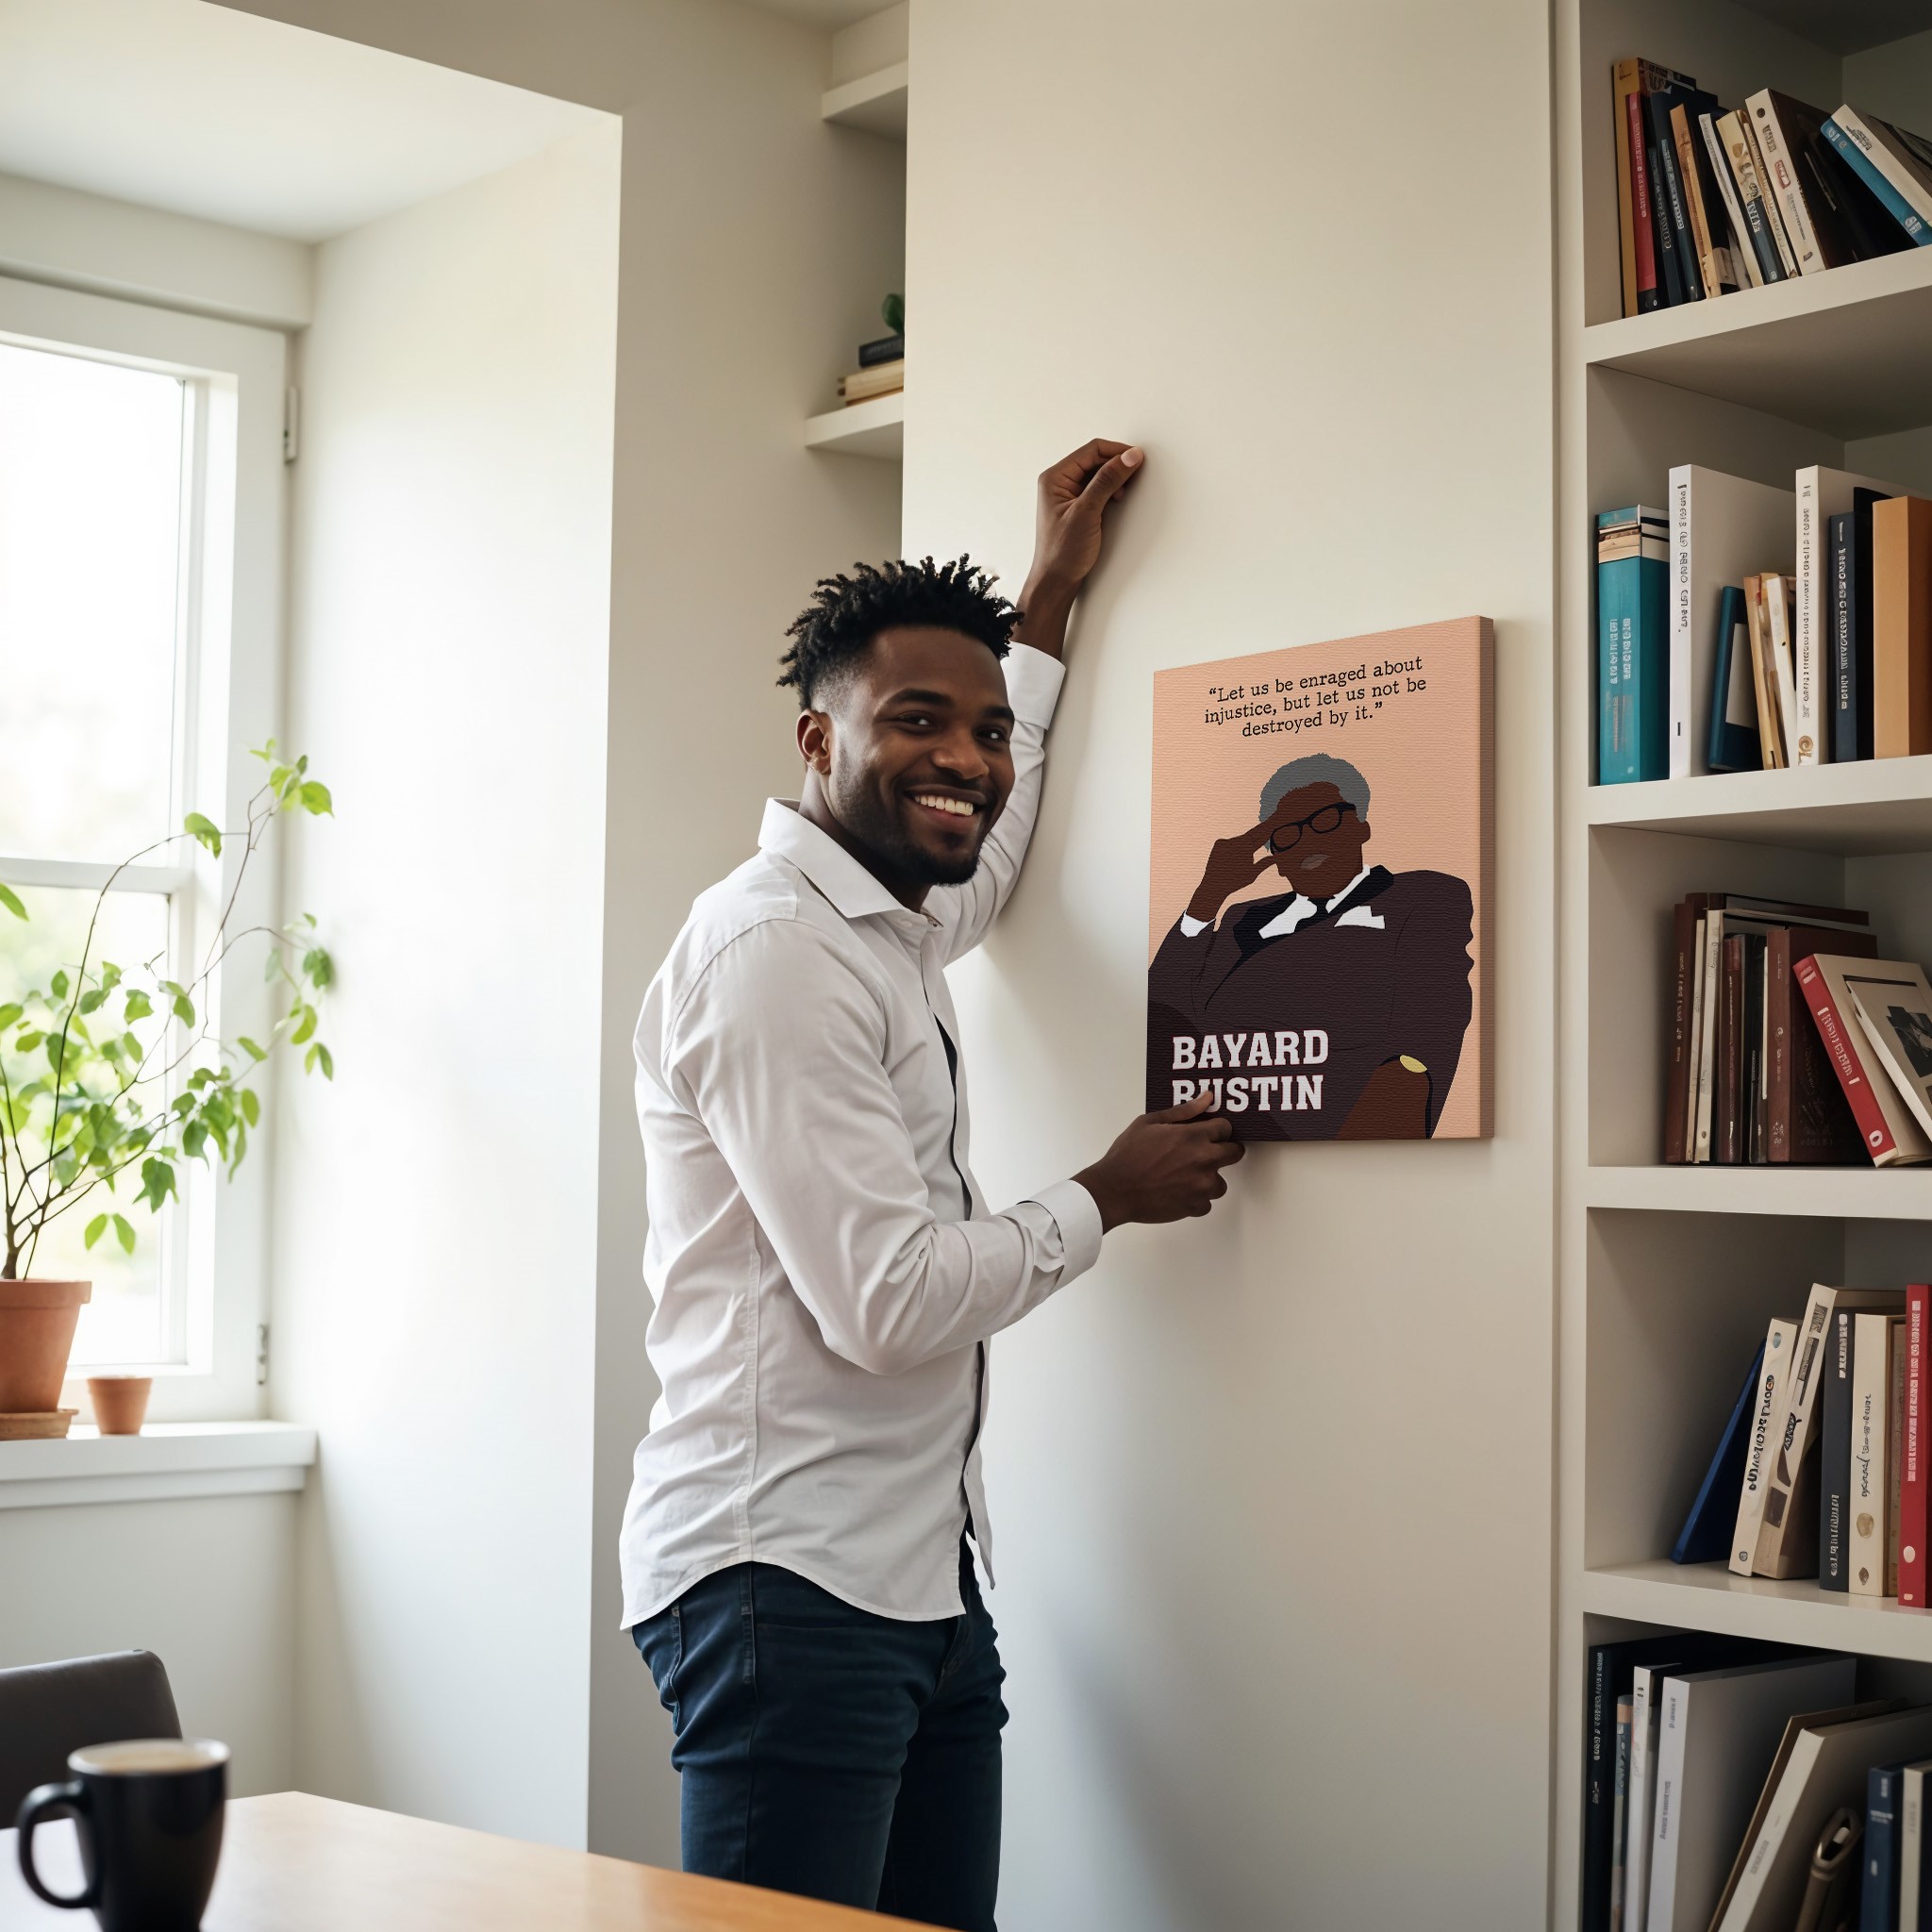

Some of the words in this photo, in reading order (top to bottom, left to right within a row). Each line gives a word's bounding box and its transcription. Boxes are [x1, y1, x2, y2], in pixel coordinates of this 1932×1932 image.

[1251, 683, 1269, 697] us
[1275, 678, 1293, 693] be
[1300, 664, 1367, 689] enraged
[1373, 656, 1423, 677] about
[1205, 702, 1277, 725] injustice,
[1284, 694, 1310, 712] but
[1317, 690, 1340, 707] let
[1346, 688, 1365, 702] us
[1372, 680, 1400, 698] not
[1407, 677, 1426, 693] be
[1242, 710, 1323, 737] destroyed
[1329, 709, 1349, 727] by
[1172, 1029, 1329, 1070] BAYARD
